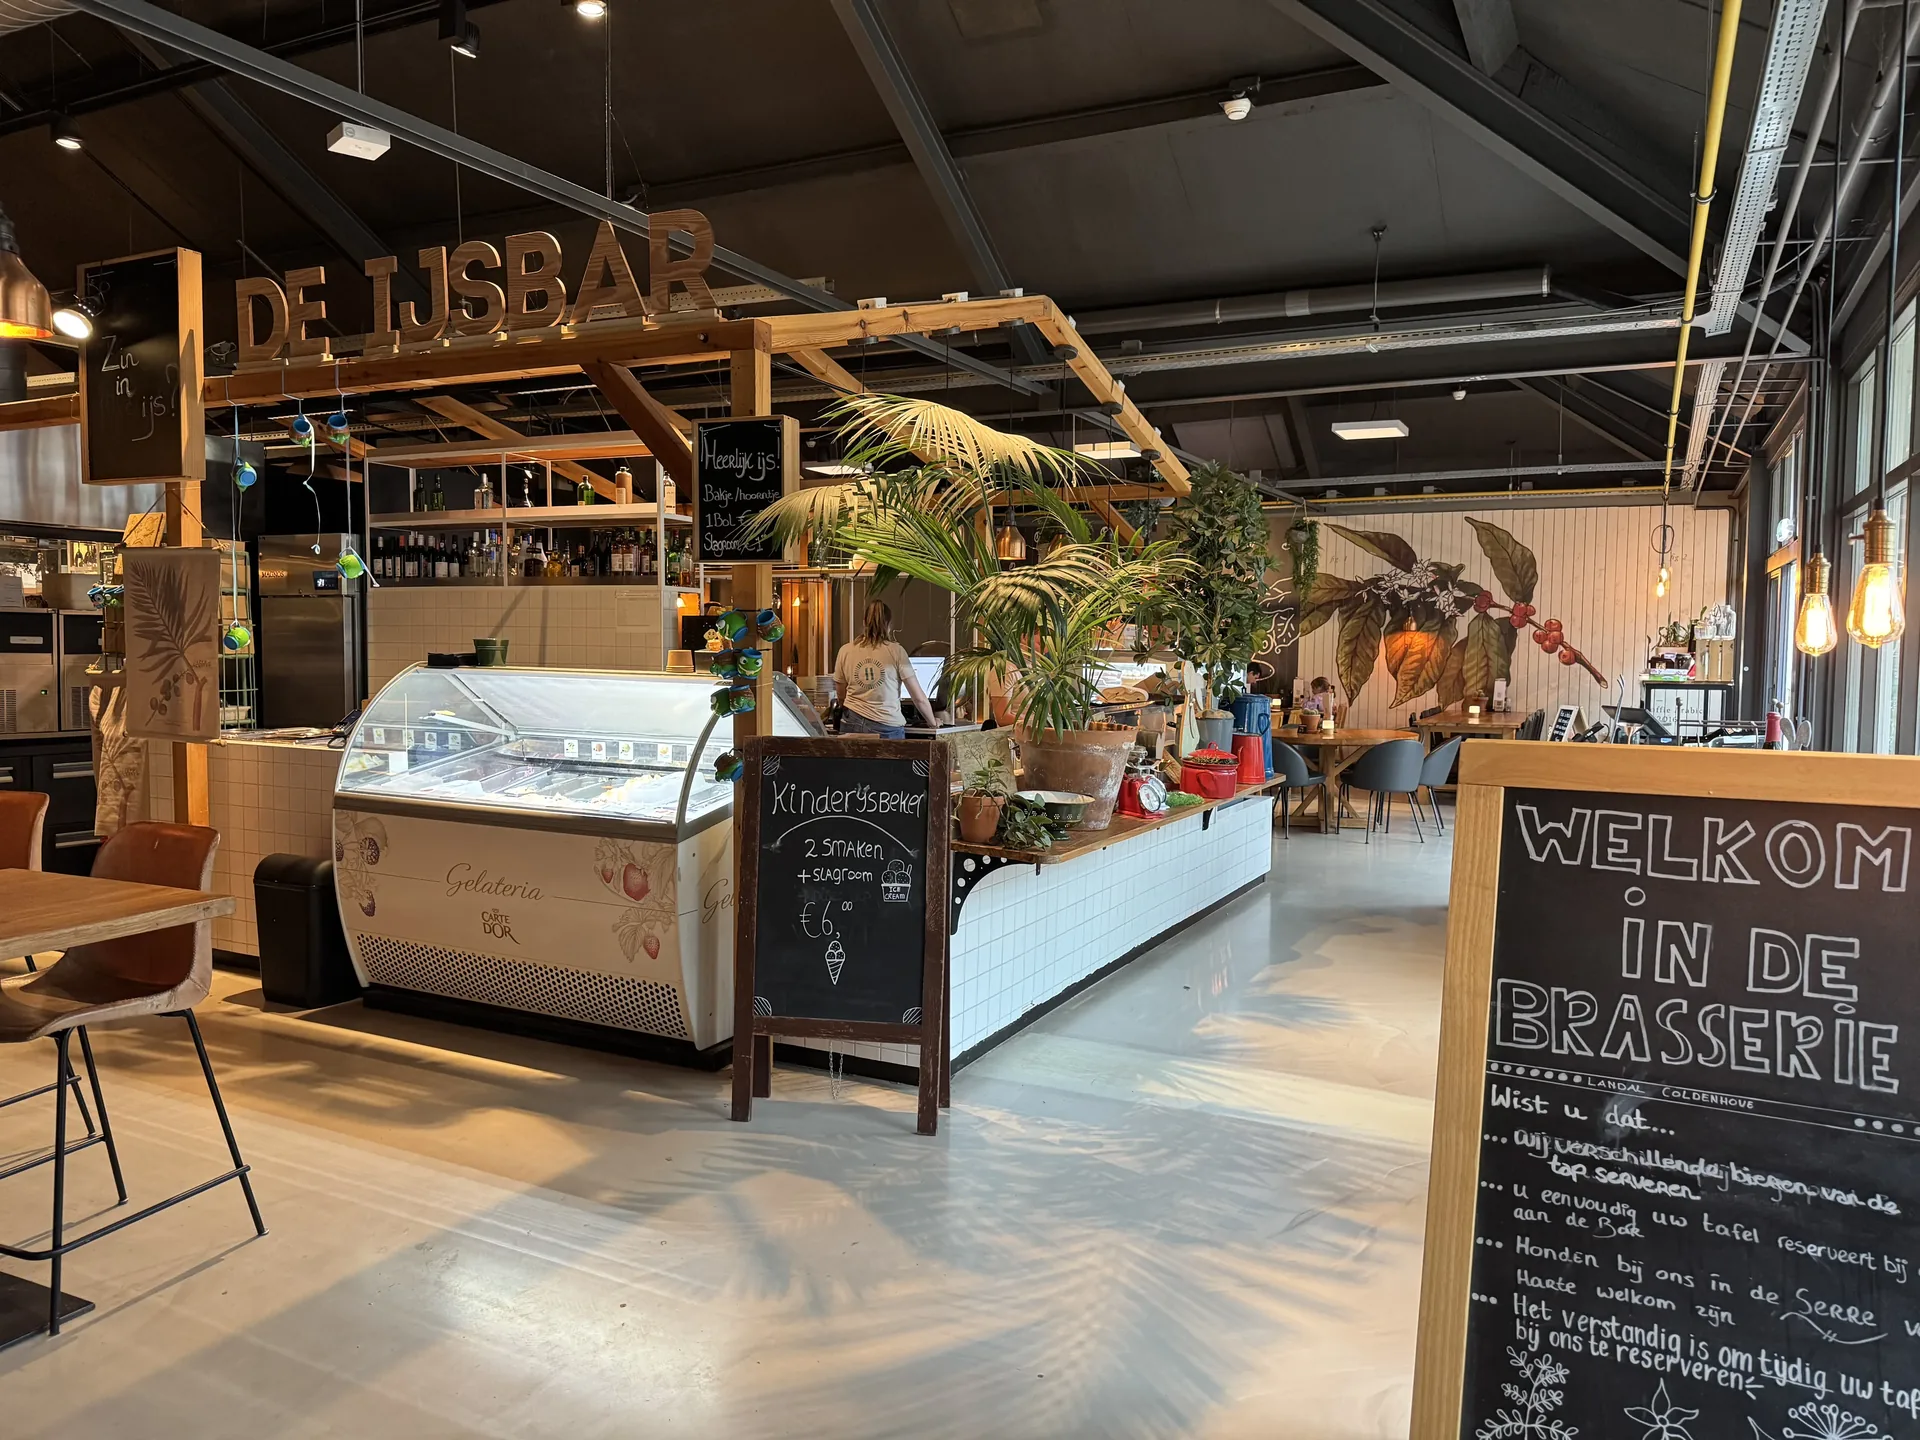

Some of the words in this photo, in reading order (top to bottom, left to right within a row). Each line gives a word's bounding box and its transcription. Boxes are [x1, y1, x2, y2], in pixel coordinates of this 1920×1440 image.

[235, 266, 331, 362] DE
[363, 208, 722, 352] IJSBAR
[101, 335, 139, 371] Zin
[116, 376, 135, 397] in
[704, 436, 754, 478] Heerlijk
[804, 838, 818, 858] 2
[1516, 805, 1912, 892] WELKOM
[446, 862, 544, 901] Gelateria
[884, 892, 906, 900] CREAM
[481, 911, 511, 925] CARTE
[1747, 928, 1859, 1002] DE
[1491, 1085, 1548, 1115] Wist
[1565, 1104, 1588, 1120] u
[1587, 1076, 1646, 1094] LANDAL
[1513, 1183, 1529, 1199] u
[1541, 1189, 1637, 1228] eenvoudig
[1652, 1209, 1688, 1228] uw
[1703, 1212, 1760, 1244] tafel
[1777, 1235, 1877, 1270] reserveert
[1884, 1254, 1909, 1284] bij
[1514, 1207, 1551, 1223] aan
[1566, 1210, 1591, 1229] de
[1516, 1235, 1600, 1267] Honden
[1617, 1255, 1645, 1284] bij
[1655, 1268, 1695, 1288] ons
[1710, 1273, 1734, 1294] in
[1750, 1284, 1780, 1304] de
[1596, 1285, 1676, 1311] welkom
[1513, 1292, 1553, 1321] Het
[1562, 1308, 1681, 1354] verstandig
[1689, 1333, 1710, 1360] is
[1719, 1346, 1754, 1372] om
[1840, 1372, 1873, 1399] uw
[1516, 1319, 1541, 1352] bij
[1549, 1329, 1584, 1354] ons
[1590, 1337, 1611, 1359] te
[1615, 1341, 1744, 1391] reserveren
